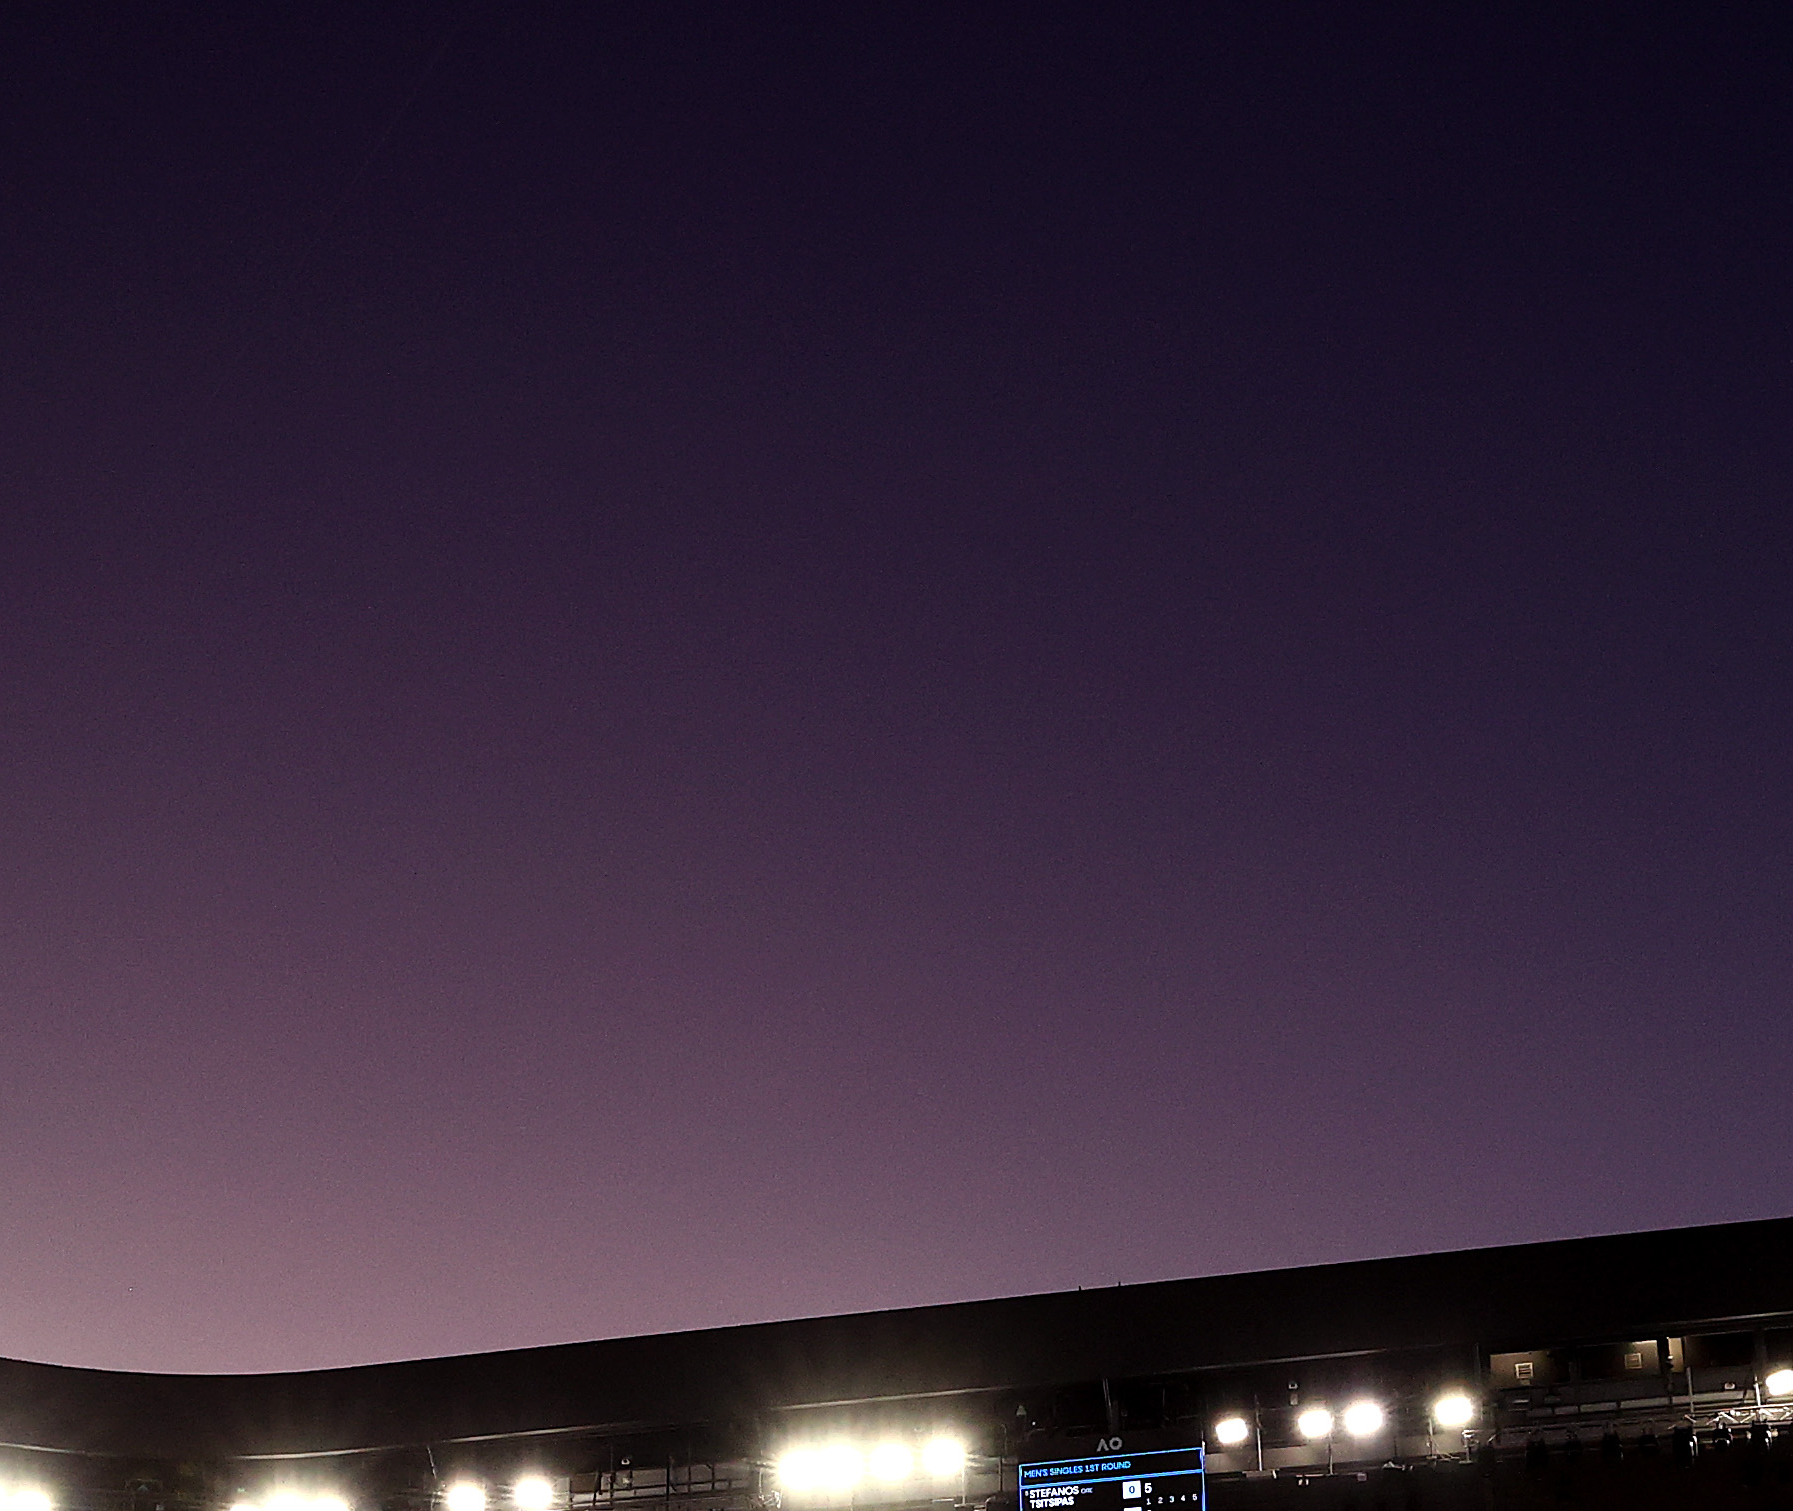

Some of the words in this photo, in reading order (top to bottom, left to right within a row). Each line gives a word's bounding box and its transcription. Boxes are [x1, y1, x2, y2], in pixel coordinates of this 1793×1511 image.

[1097, 1437, 1122, 1452] AO
[1050, 1466, 1083, 1475] SINGLES
[1101, 1461, 1131, 1471] ROUND
[1029, 1486, 1080, 1499] STEFANOS
[1144, 1482, 1152, 1494] 5
[1029, 1496, 1074, 1509] TSITSIPAS
[1146, 1497, 1151, 1505] 1
[1158, 1496, 1163, 1504] 2
[1169, 1495, 1175, 1503] 3
[1180, 1494, 1186, 1502] 4
[1192, 1493, 1198, 1501] 5
